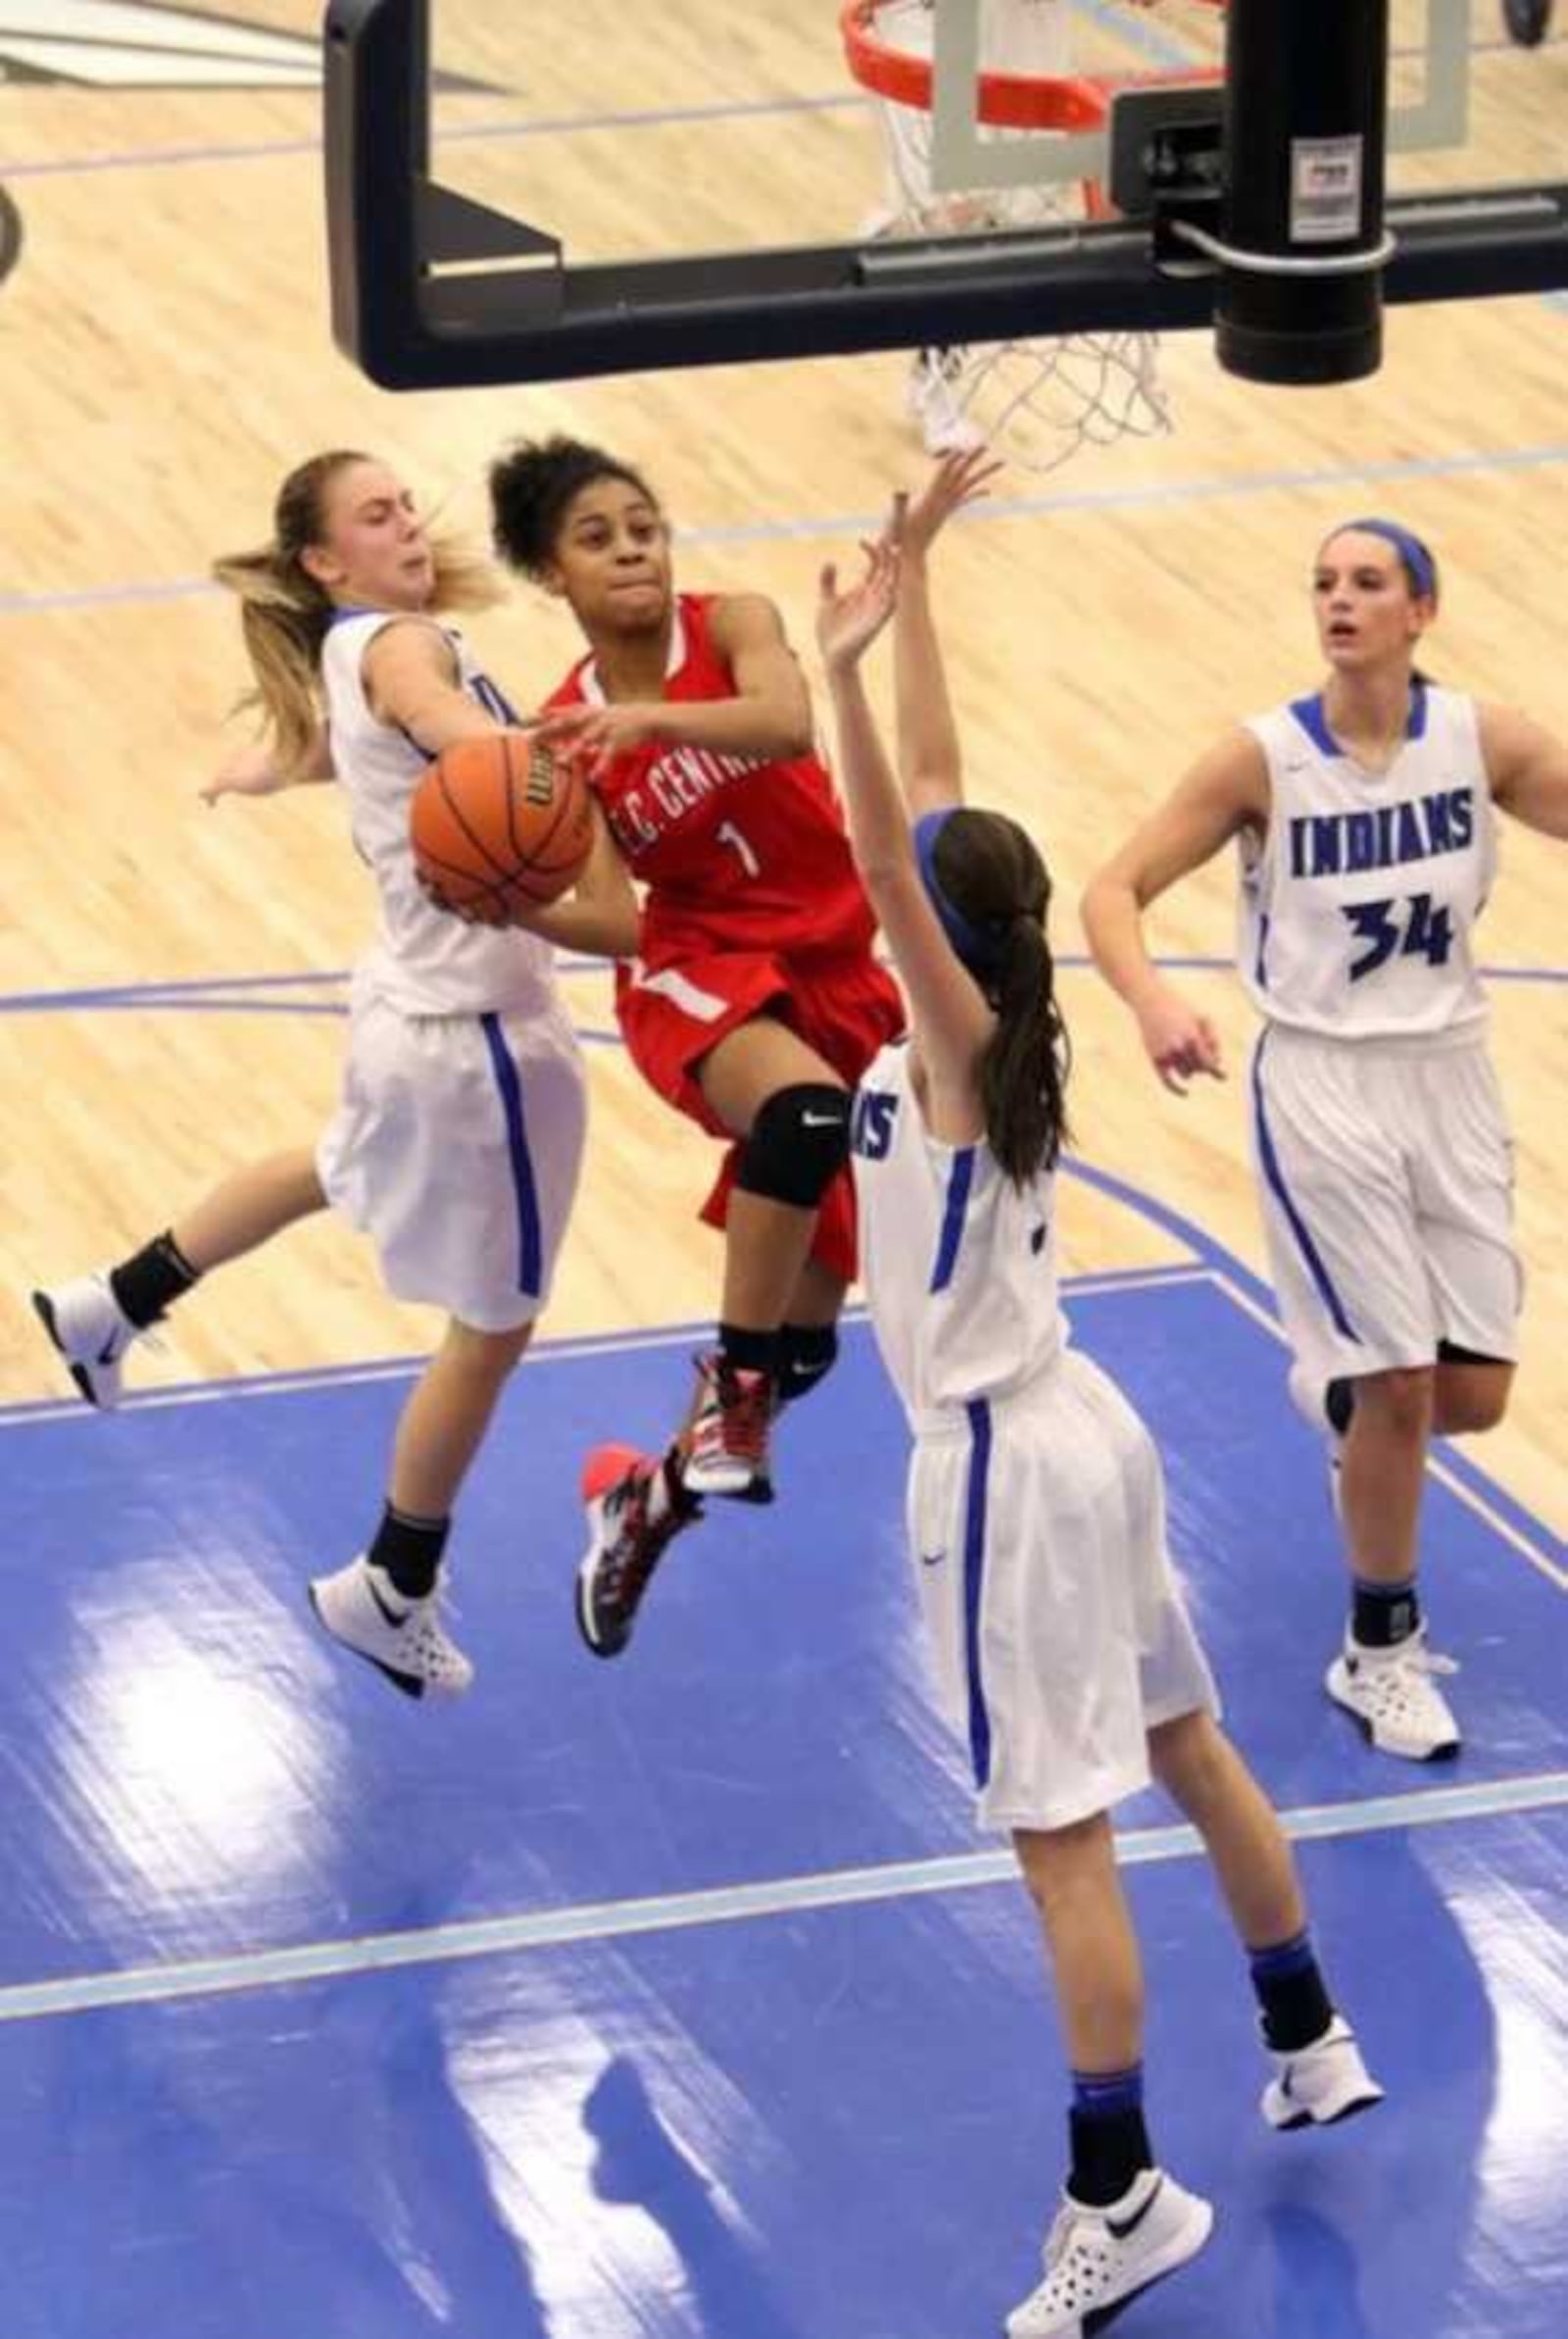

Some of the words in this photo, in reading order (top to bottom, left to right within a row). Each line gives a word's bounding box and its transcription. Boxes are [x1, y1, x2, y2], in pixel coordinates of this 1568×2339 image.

[716, 821, 760, 878] 1
[1291, 788, 1473, 877] INDIANS
[1341, 892, 1453, 983] 34
